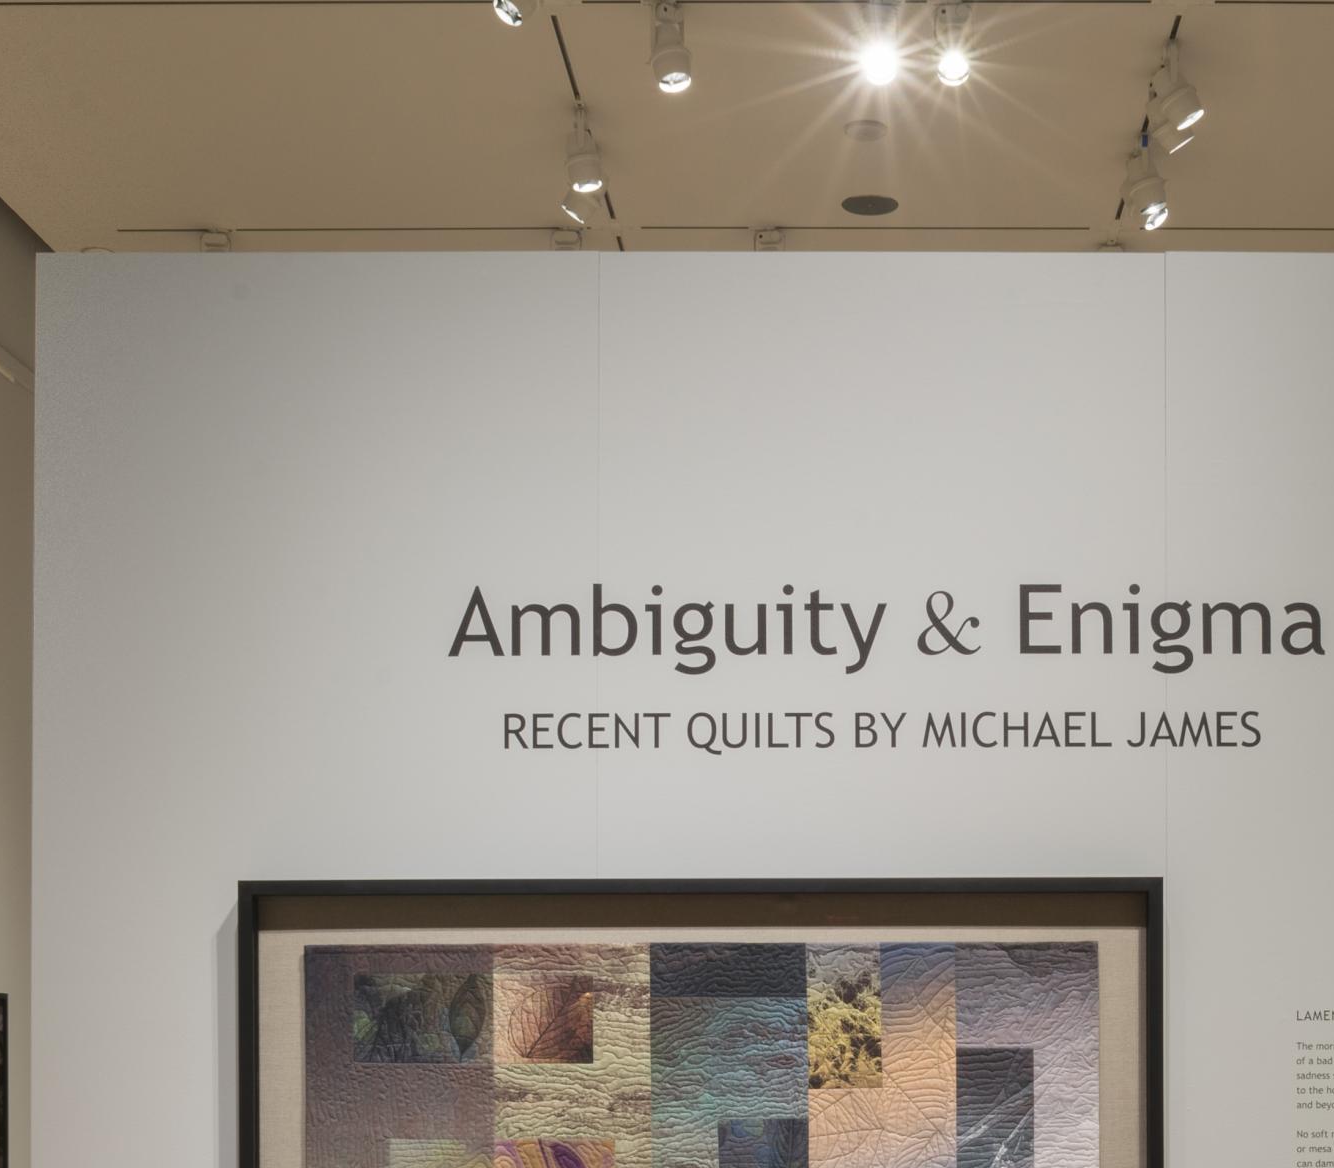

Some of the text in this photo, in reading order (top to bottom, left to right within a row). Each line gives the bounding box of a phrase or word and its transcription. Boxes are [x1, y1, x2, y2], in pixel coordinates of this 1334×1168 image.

[448, 584, 1325, 675] Ambiguity & Enigma
[504, 711, 1261, 755] RECENT QUILTS BY MICHAEL JAMES
[1296, 1042, 1314, 1050] The
[1296, 1056, 1306, 1065] of
[1316, 1056, 1333, 1065] bad
[1296, 1071, 1331, 1080] sadness
[1296, 1086, 1306, 1094] to
[1308, 1086, 1324, 1094] the
[1296, 1100, 1313, 1109] and
[1296, 1129, 1309, 1138] No
[1310, 1129, 1329, 1138] soft
[1314, 1159, 1334, 1167] dam
